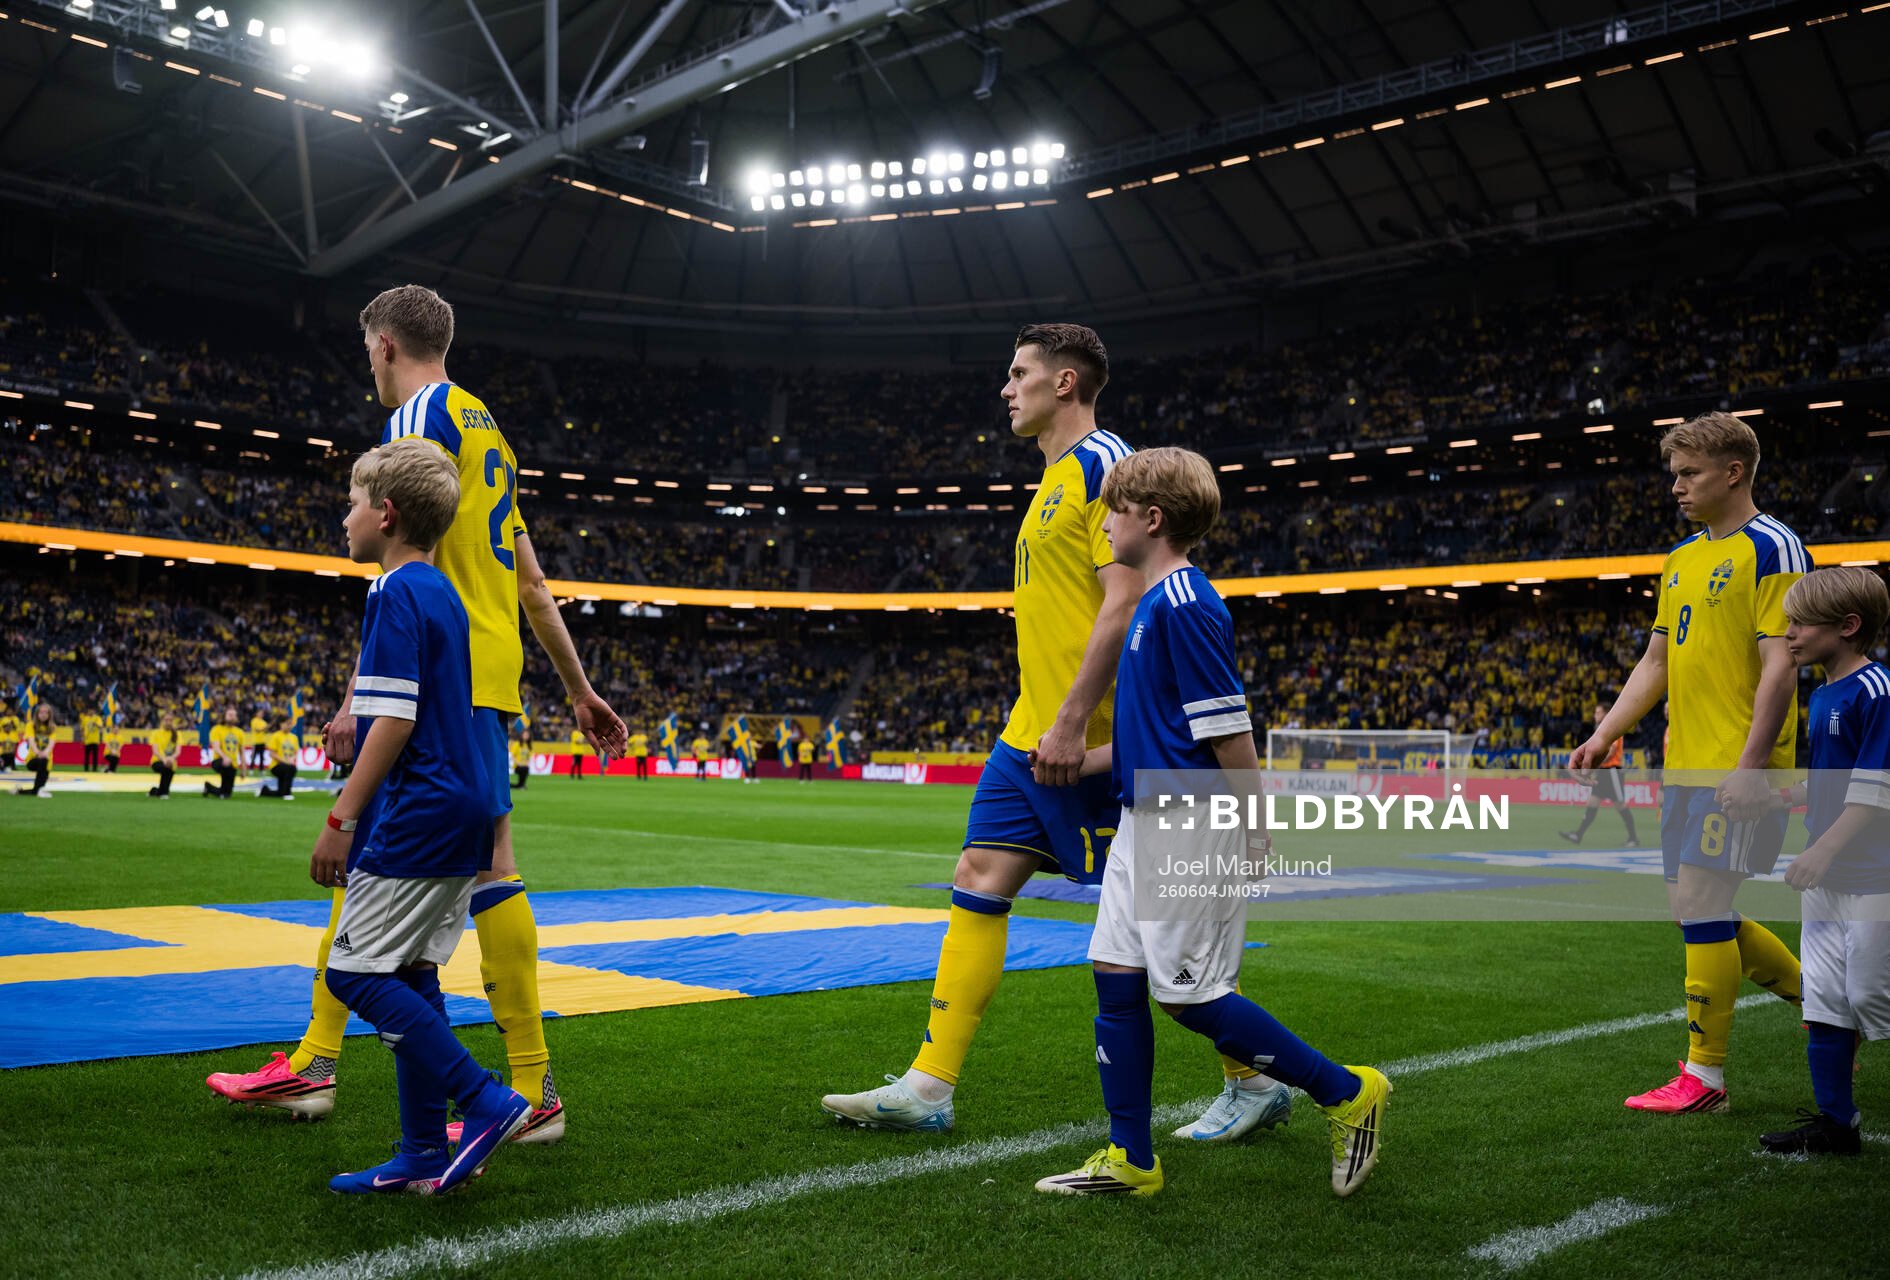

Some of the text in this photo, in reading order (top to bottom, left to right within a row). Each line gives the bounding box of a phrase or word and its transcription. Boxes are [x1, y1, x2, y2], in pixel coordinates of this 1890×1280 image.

[1676, 605, 1692, 645] 8
[1539, 782, 1654, 804] SVENS PEL
[1700, 813, 1728, 857] 8
[1172, 978, 1196, 986] adidas
